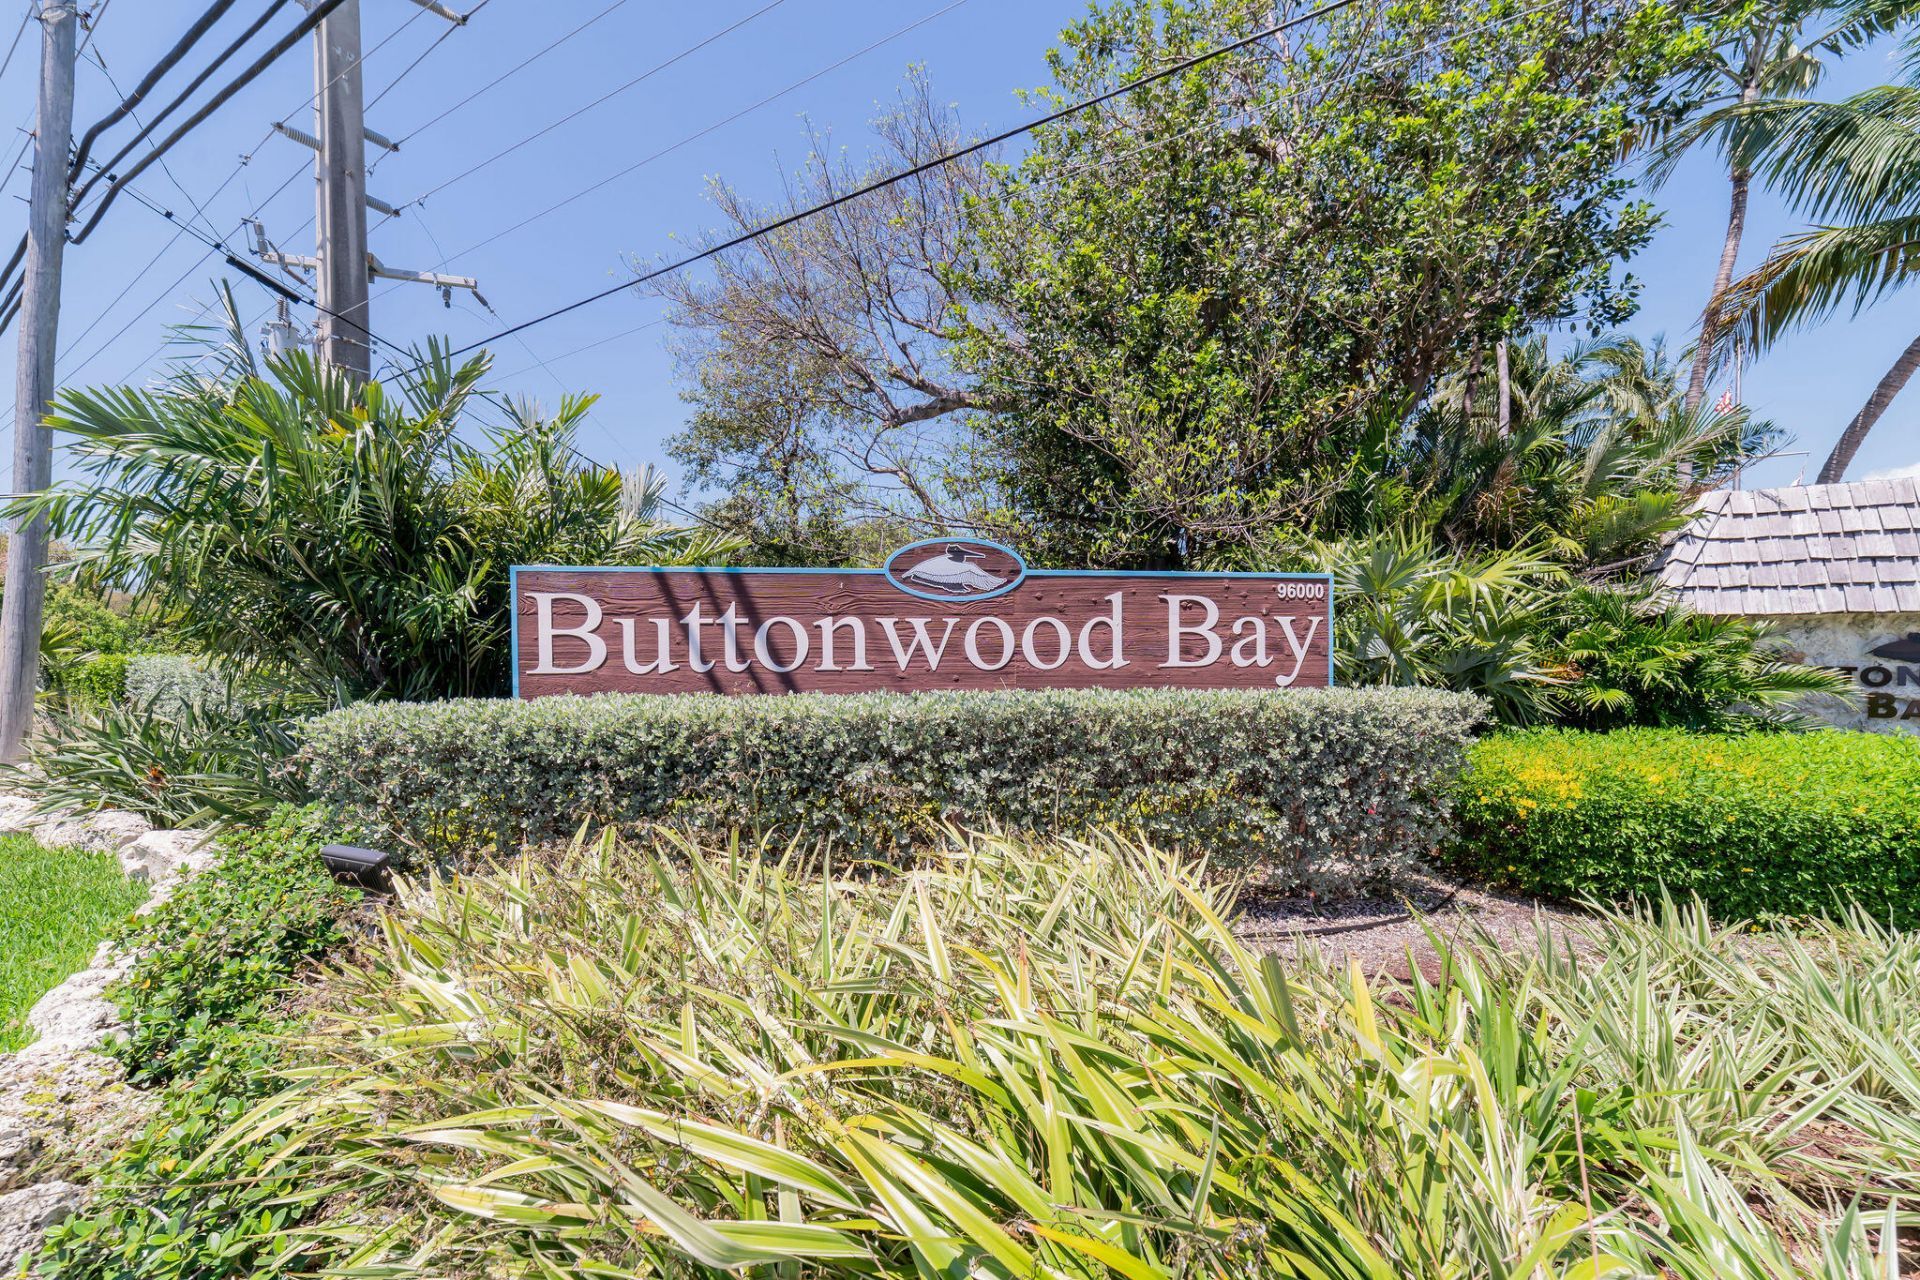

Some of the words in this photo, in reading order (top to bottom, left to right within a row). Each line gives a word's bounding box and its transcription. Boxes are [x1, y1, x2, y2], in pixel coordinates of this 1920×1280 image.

[1277, 583, 1325, 599] 96000
[525, 591, 1131, 675] Buttonwood
[1158, 594, 1324, 687] Bay
[1824, 665, 1920, 687] TON
